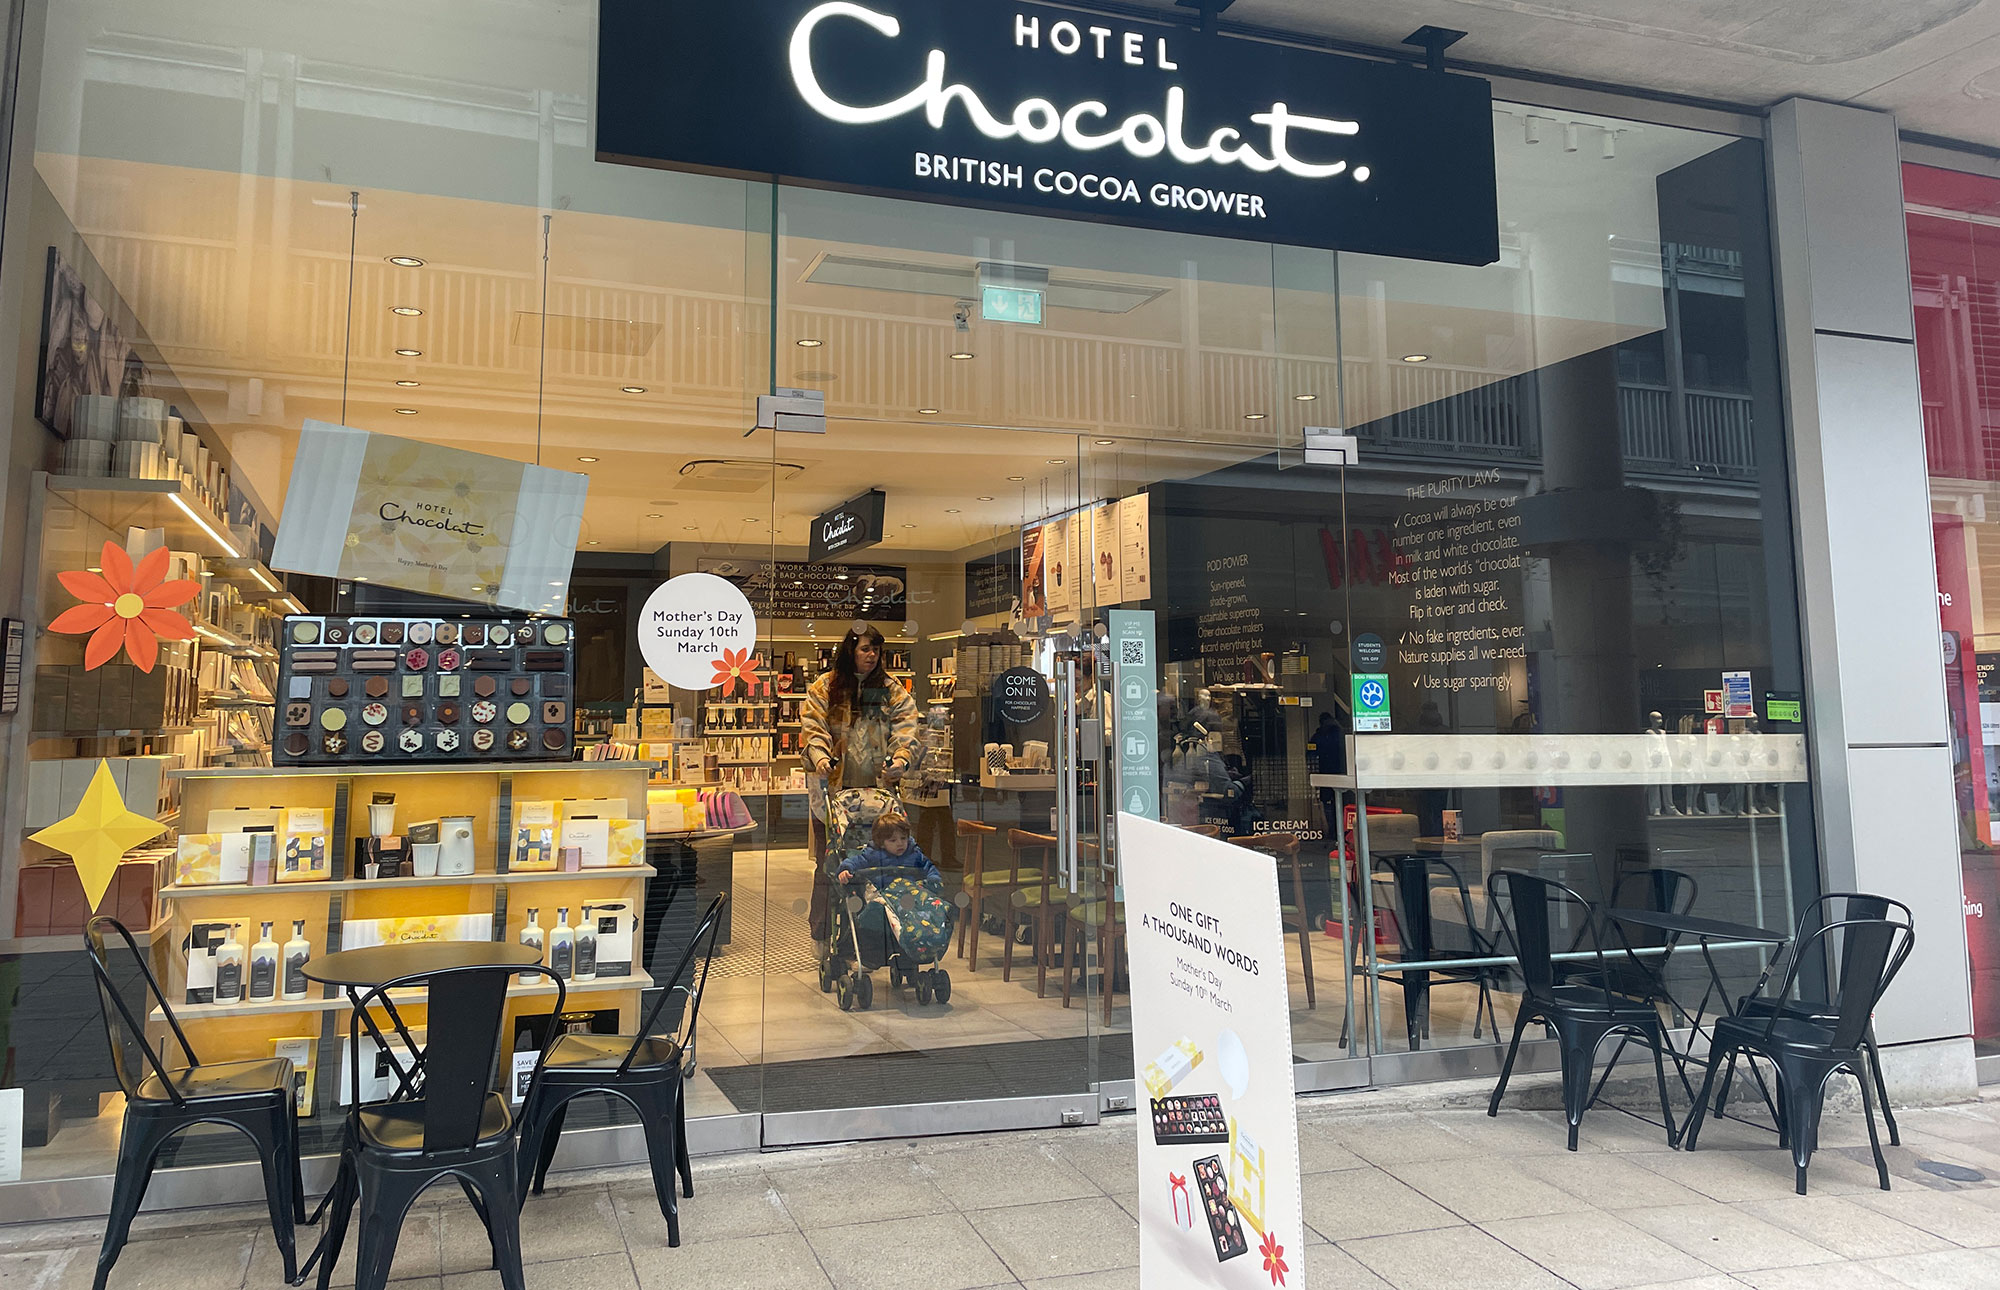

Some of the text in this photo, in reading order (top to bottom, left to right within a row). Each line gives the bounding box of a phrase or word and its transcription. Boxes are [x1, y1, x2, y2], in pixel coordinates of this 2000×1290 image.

[1015, 14, 1178, 70] HOTEL
[914, 152, 1266, 218] BRITISH COCOA GROWER
[1406, 468, 1500, 501] THE PURITY LAWS
[417, 503, 453, 515] HOTEL
[1403, 496, 1518, 527] Cocoa will always be our
[1392, 515, 1521, 547] number one ingredient, even
[1395, 535, 1520, 566] in milk and white chocolate.
[1207, 554, 1248, 572] POD POWER
[1388, 570, 1409, 584] Most
[1412, 567, 1421, 581] of
[1423, 567, 1438, 580] the
[1440, 560, 1473, 577] world's
[1415, 580, 1500, 600] is laden with sugar.
[750, 601, 778, 609] Engagd
[1409, 596, 1508, 622] Flip it over and check.
[653, 611, 742, 624] Mother's Day
[1199, 609, 1228, 623] sustainable
[657, 626, 738, 640] Sunday 10th
[1197, 622, 1264, 638] Other chocolate makers
[1409, 625, 1525, 646] No fake ingredients, ever.
[678, 642, 718, 653] March
[1220, 640, 1250, 653] everything
[1251, 638, 1262, 649] but
[1399, 643, 1527, 666] Nature supplies all we need.
[1207, 656, 1216, 667] the
[1217, 657, 1234, 666] cocoa
[1006, 676, 1036, 685] COME
[1212, 672, 1223, 682] We
[1225, 673, 1235, 681] use
[1235, 672, 1241, 681] it
[1423, 672, 1513, 692] Use sugar sparingly.
[1005, 687, 1037, 696] ON IN
[1253, 820, 1309, 831] ICE CREAM
[1295, 831, 1323, 840] GODS
[1170, 902, 1223, 938] ONE GIFT,
[1142, 913, 1259, 976] A THOUSAND WORDS
[1176, 957, 1222, 991] Mother's Day
[1170, 972, 1233, 1013] Sunday 10th March
